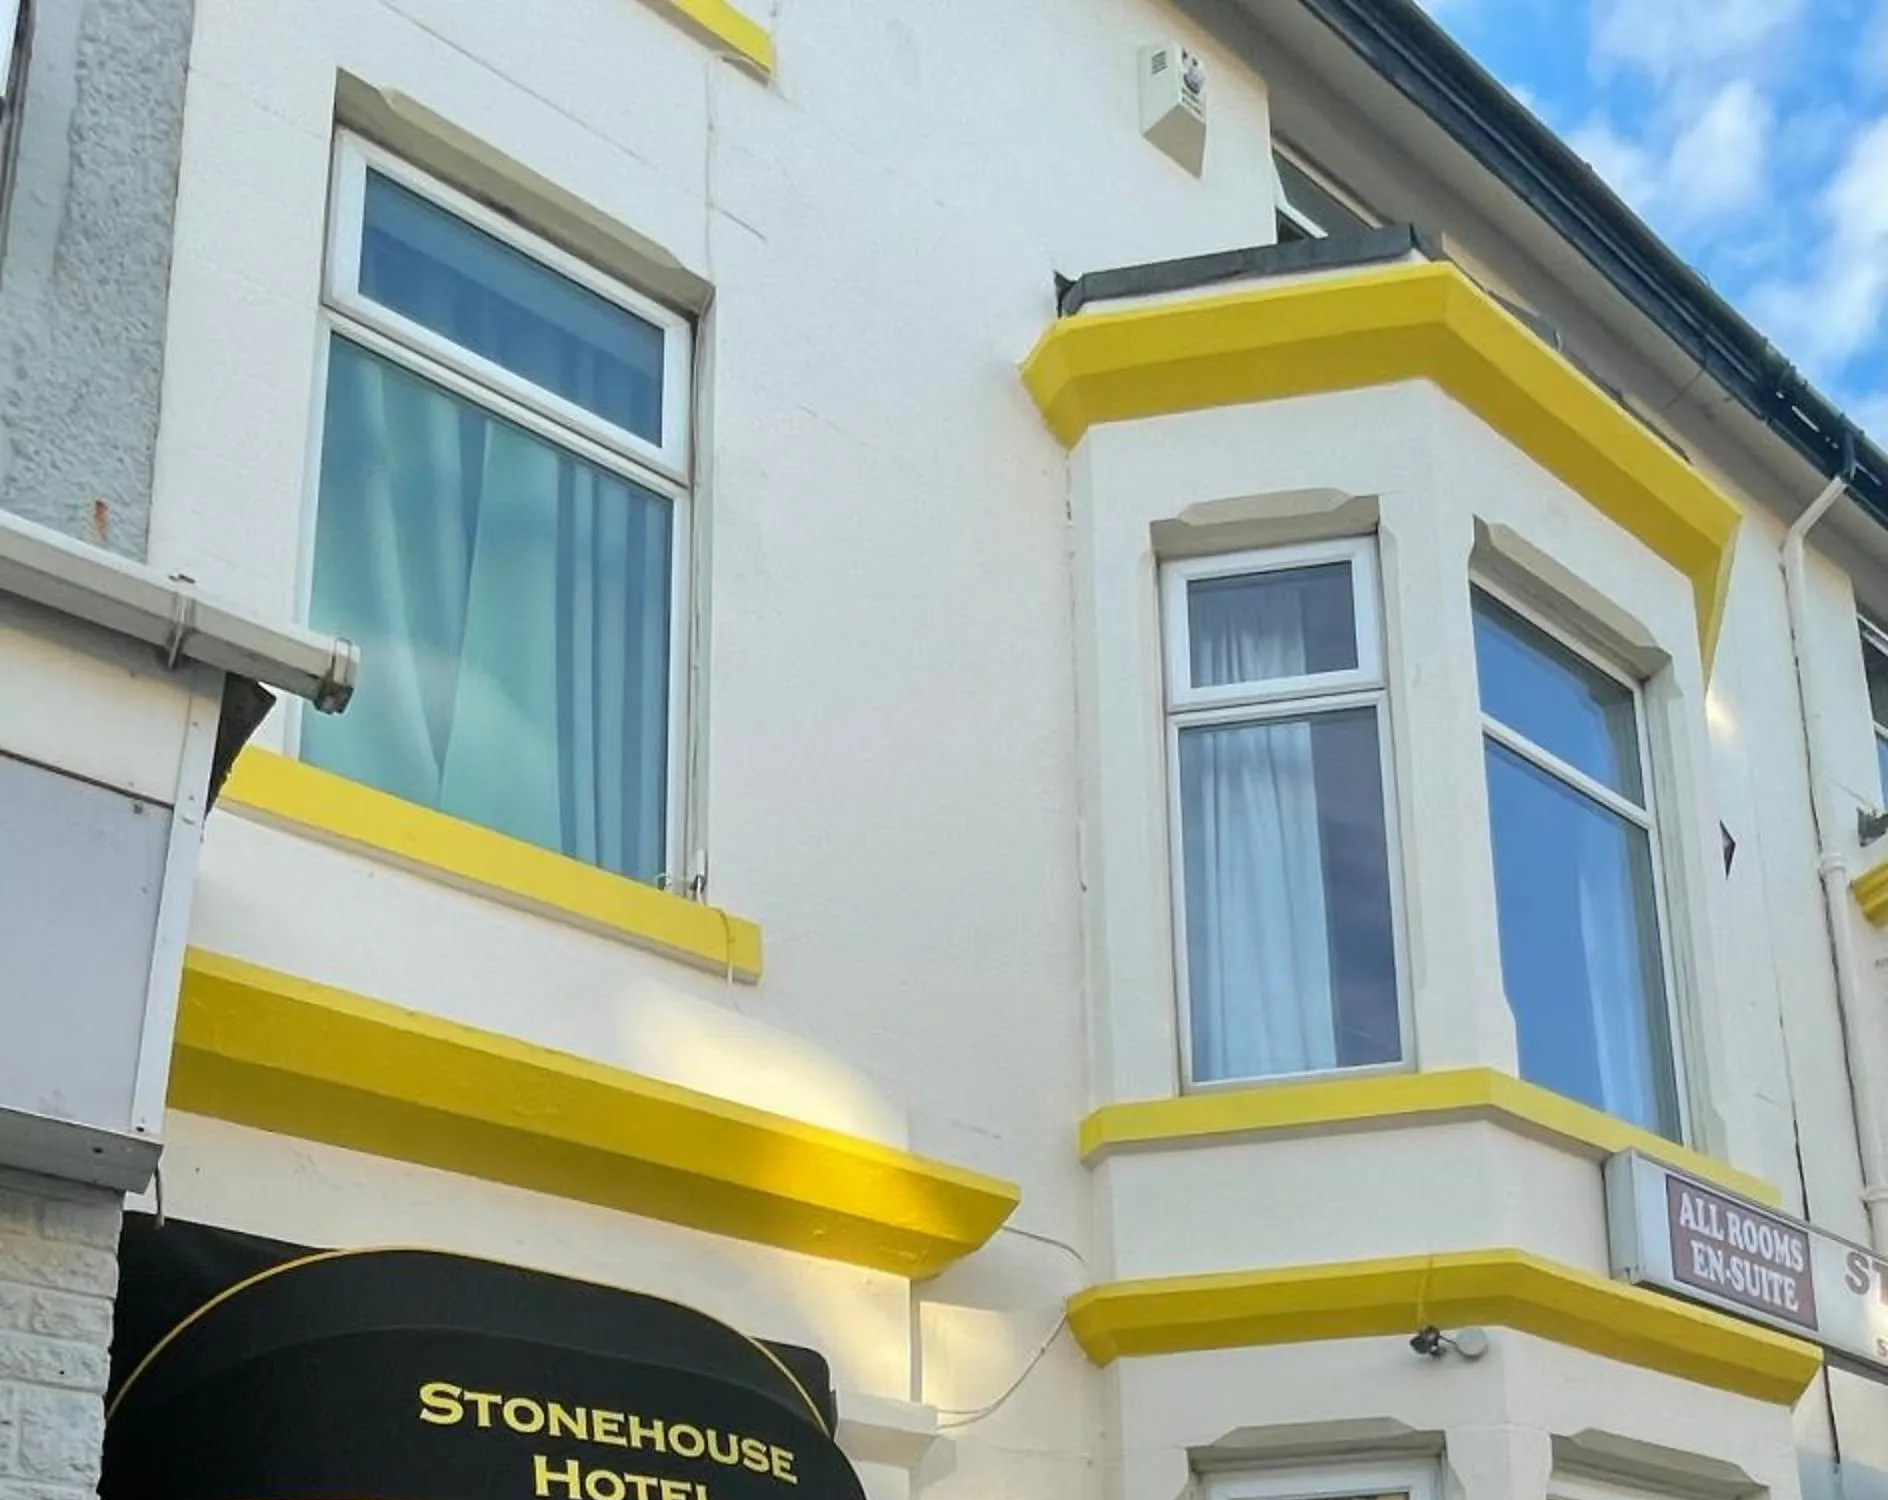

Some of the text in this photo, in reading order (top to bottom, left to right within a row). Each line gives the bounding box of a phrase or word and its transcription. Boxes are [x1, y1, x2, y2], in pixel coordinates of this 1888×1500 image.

[1679, 1191, 1804, 1274] ALL ROOMS
[1690, 1239, 1800, 1313] EN-SUITE
[418, 1380, 799, 1485] STONEHOUSE
